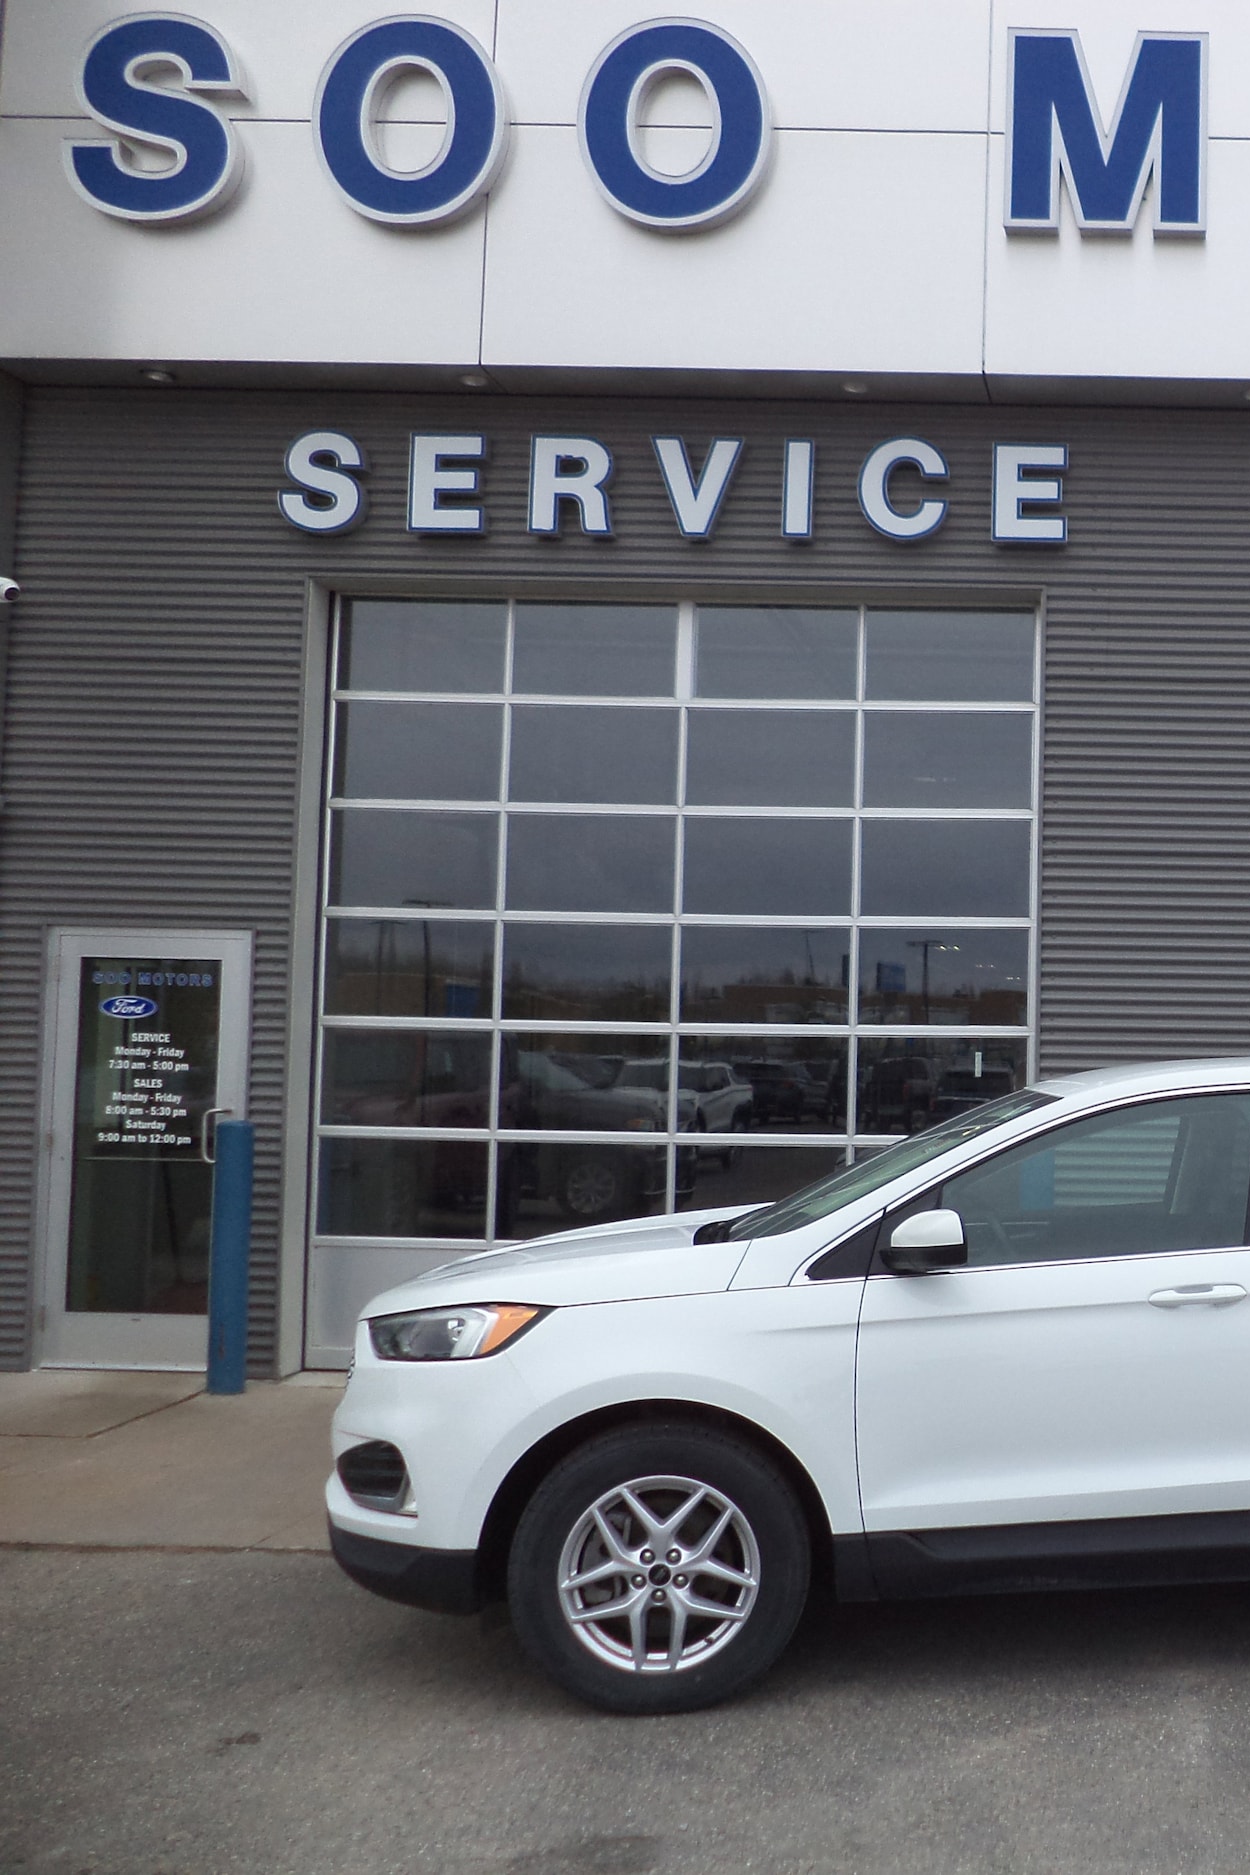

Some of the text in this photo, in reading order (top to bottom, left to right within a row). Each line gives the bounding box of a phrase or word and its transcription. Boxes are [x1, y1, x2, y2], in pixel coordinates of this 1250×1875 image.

[63, 11, 774, 233] SOO
[278, 431, 1070, 544] SERVICE
[92, 971, 213, 986] SOO MOTORS
[111, 998, 147, 1014] Ford
[131, 1032, 171, 1043] SERVICE
[114, 1046, 152, 1058] Monday
[158, 1047, 185, 1059] Friday
[109, 1060, 130, 1070] 7:30
[131, 1061, 145, 1070] am
[152, 1061, 174, 1070] 5:00
[175, 1062, 190, 1072] pm
[133, 1079, 163, 1088] SALES
[112, 1092, 149, 1104] Monday
[155, 1093, 182, 1105] Friday
[129, 1107, 143, 1115] am
[150, 1106, 171, 1116] 5:30
[172, 1108, 187, 1118] pm
[125, 1120, 167, 1132] Saturday
[98, 1133, 192, 1146] 9:00 am to 12:00 pm
